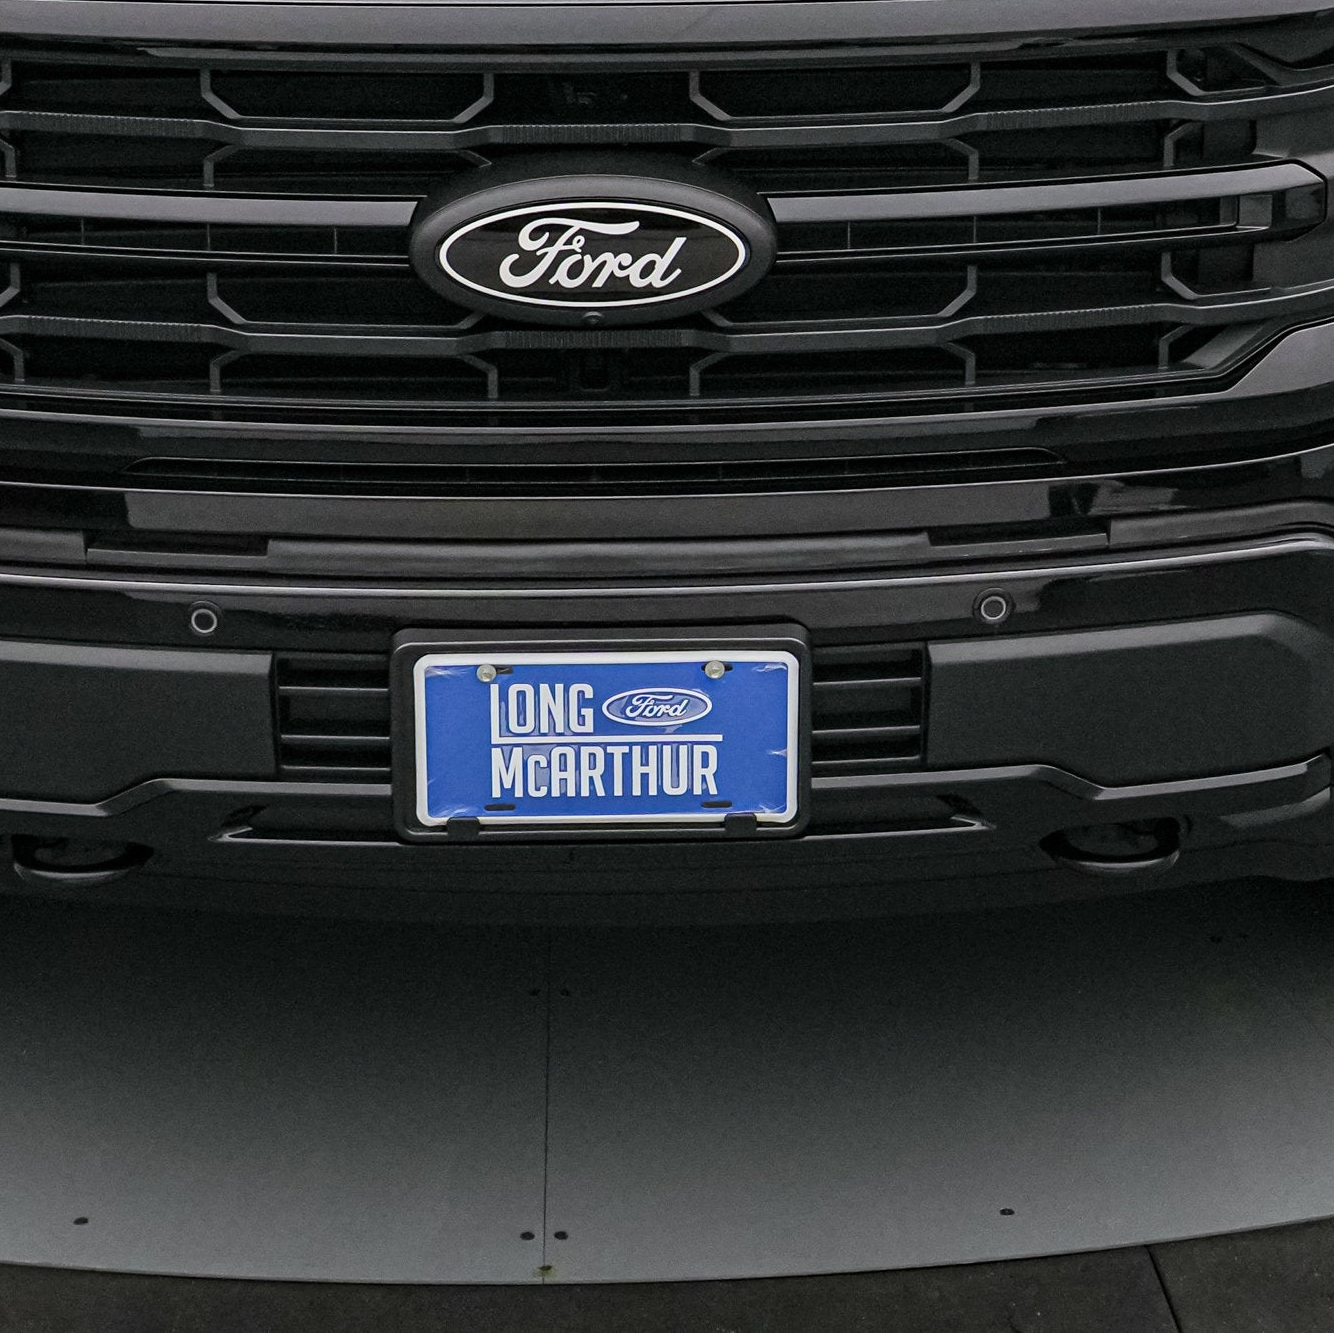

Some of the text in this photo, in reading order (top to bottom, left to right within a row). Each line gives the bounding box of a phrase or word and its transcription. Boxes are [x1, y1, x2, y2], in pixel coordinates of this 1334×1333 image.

[499, 217, 687, 289] Ford
[490, 682, 690, 744] LONG Ford
[490, 743, 719, 799] McARTHUR
